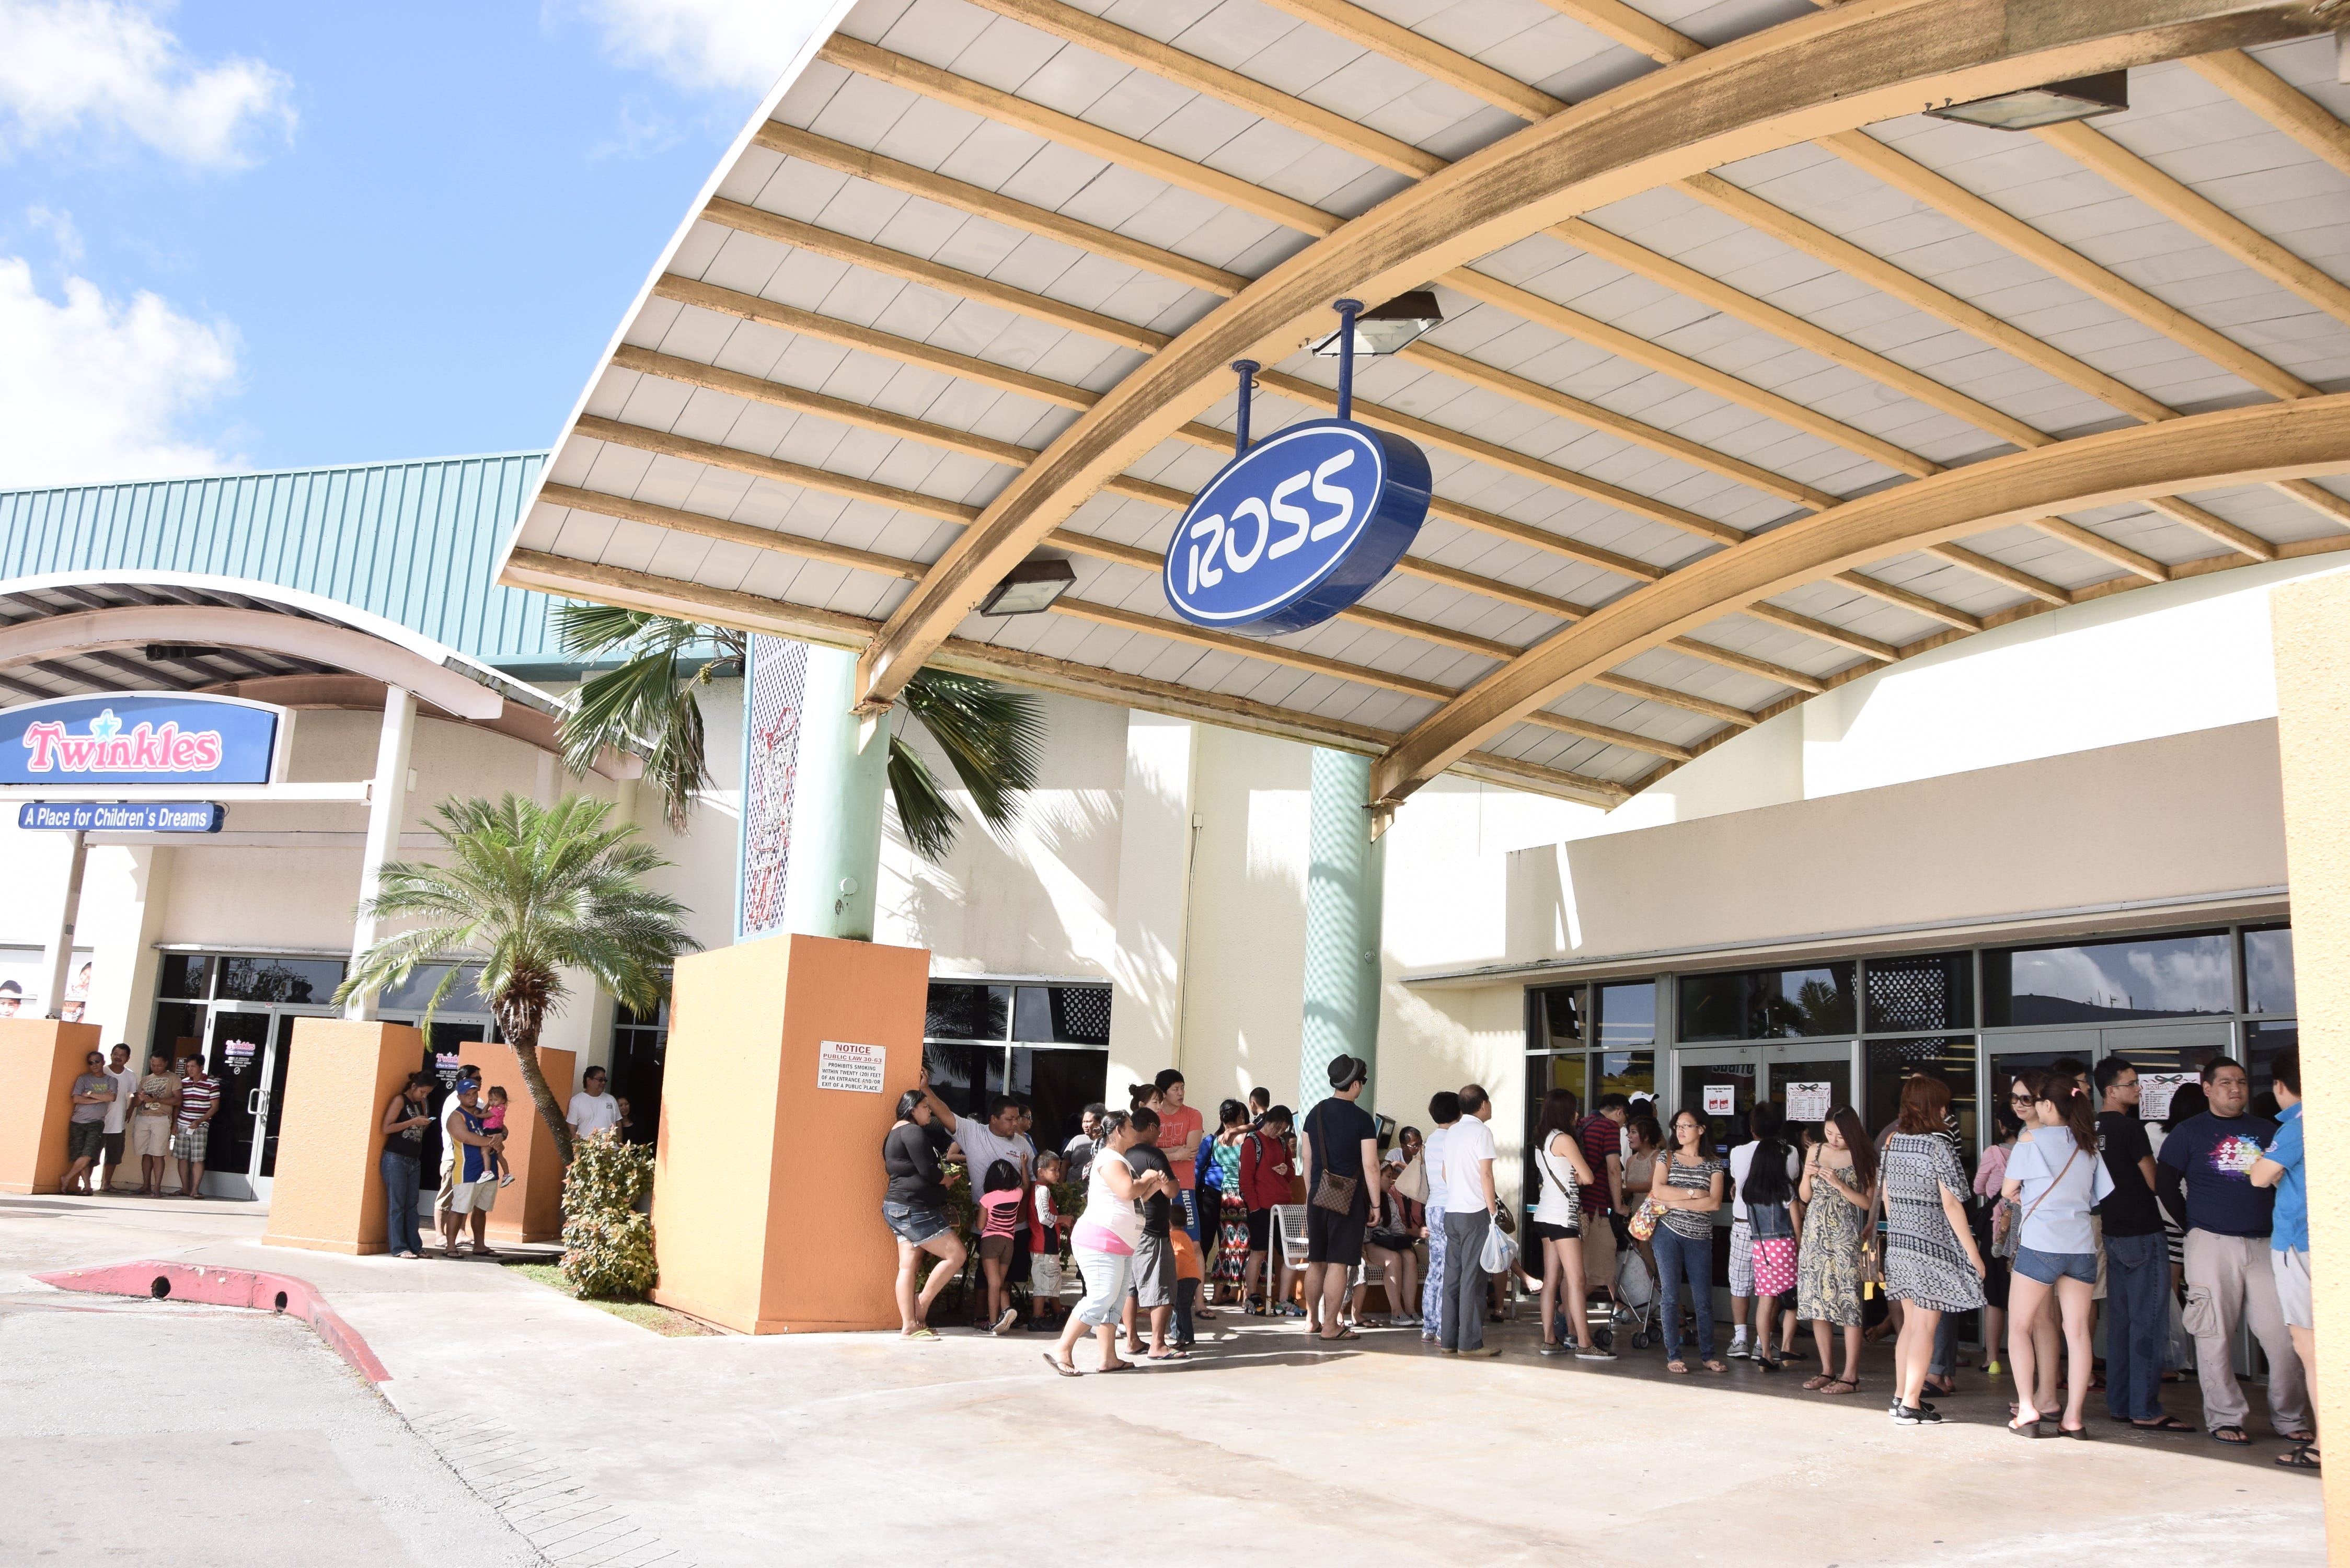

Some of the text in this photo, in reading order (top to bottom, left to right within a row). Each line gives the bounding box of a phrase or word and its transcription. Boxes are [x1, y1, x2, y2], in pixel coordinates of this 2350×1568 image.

[1188, 449, 1355, 595] ROSS
[24, 720, 222, 772] Twinkles
[24, 807, 207, 827] A Place for Children's Dreams
[226, 1040, 256, 1050] Twinkles
[836, 1044, 871, 1054] NOTICE
[436, 1053, 458, 1063] Twink
[1182, 1190, 1194, 1225] HOLLISTER
